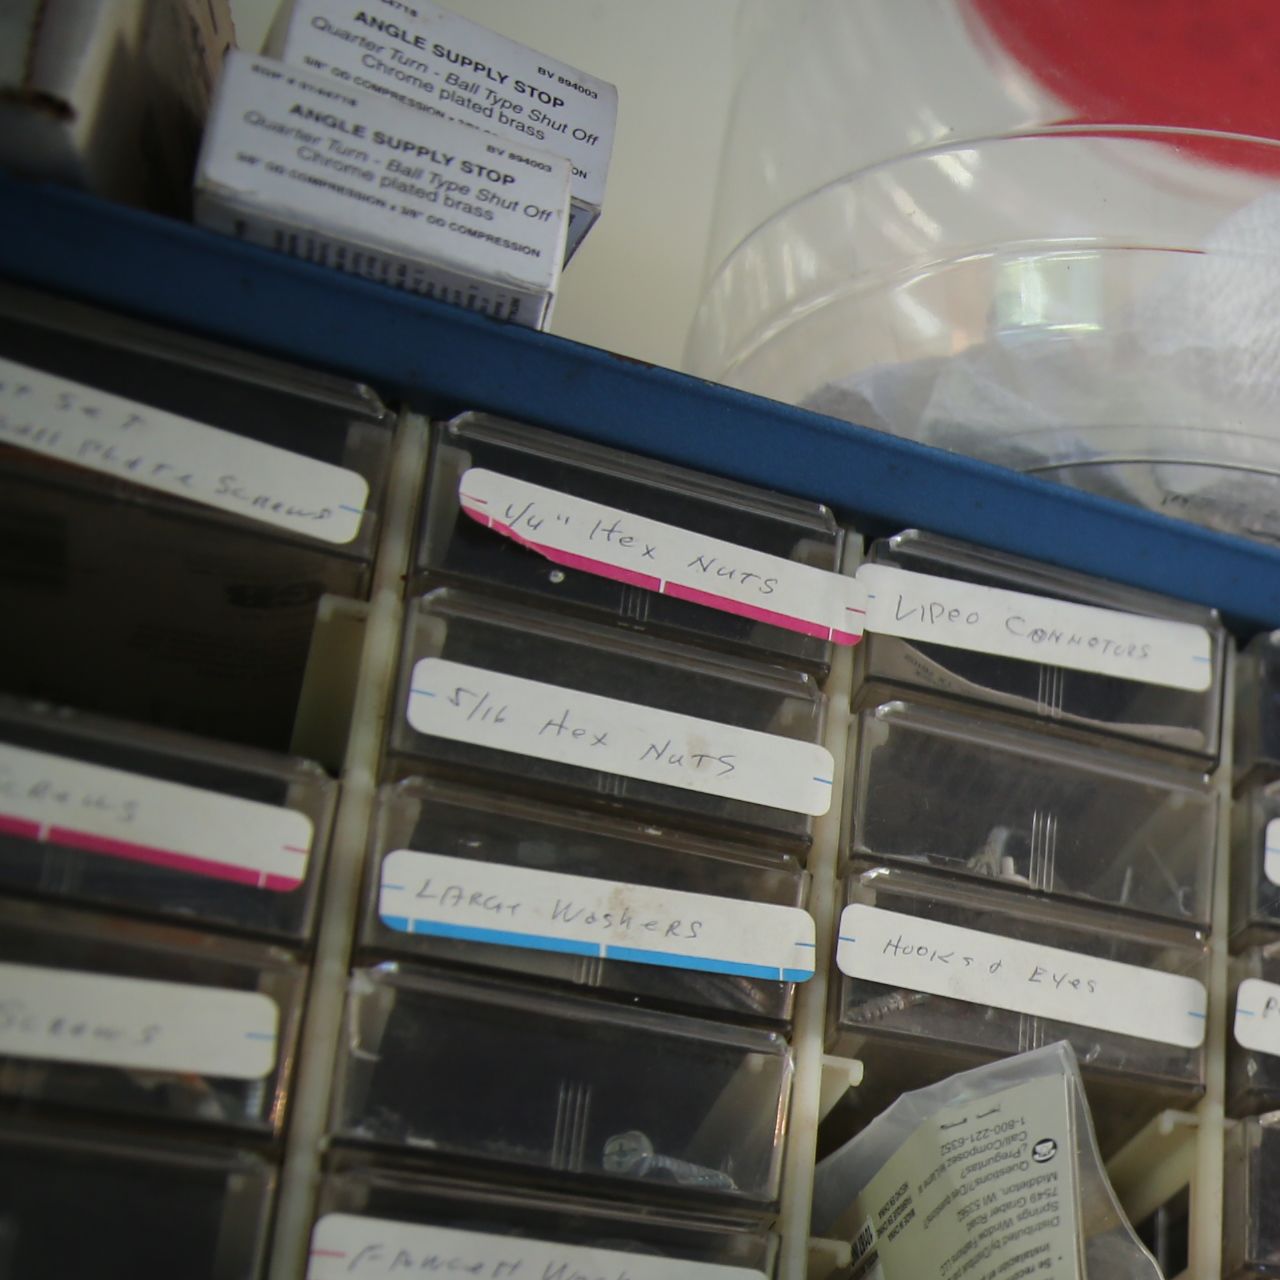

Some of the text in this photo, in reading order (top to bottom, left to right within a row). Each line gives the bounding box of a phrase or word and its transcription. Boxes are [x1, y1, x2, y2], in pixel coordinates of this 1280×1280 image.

[354, 11, 566, 109] ANGLE SUPPLY STOP
[311, 15, 387, 55] Quarter
[389, 46, 429, 74] Turn
[445, 67, 481, 95] Ball
[482, 79, 524, 116] Type
[529, 99, 569, 133] Shut
[572, 123, 601, 148] Off
[352, 73, 447, 122] COMPRESSION
[361, 53, 435, 94] Chrome
[439, 85, 494, 121] plated
[498, 109, 546, 142] brass
[537, 66, 599, 99] BV 894003
[288, 103, 516, 188] ANGLE SUPPLY STOP
[486, 143, 506, 158] BV
[508, 150, 554, 174] 894003
[243, 110, 555, 223] Quarter Turn Ball Type Shut Off
[296, 145, 496, 223] Chrome plated brass
[448, 219, 542, 260] COMPRESSION
[588, 519, 657, 560] Hex
[446, 685, 507, 724] 5/16
[538, 709, 609, 749] Hex
[939, 1116, 1025, 1155] 1-800-221-6352
[945, 1129, 1027, 1169] Call/Composez
[958, 1142, 1028, 1180] ¿Preguntas?
[982, 1192, 997, 1205] WI
[989, 1196, 1027, 1218] Graber
[1015, 1200, 1058, 1222] Springs
[1029, 1186, 1057, 1202] 7549
[978, 1217, 1013, 1240] Window
[1002, 1215, 1060, 1246] Distributed
[940, 1259, 951, 1277] LLC
[1037, 1258, 1052, 1270] Se
